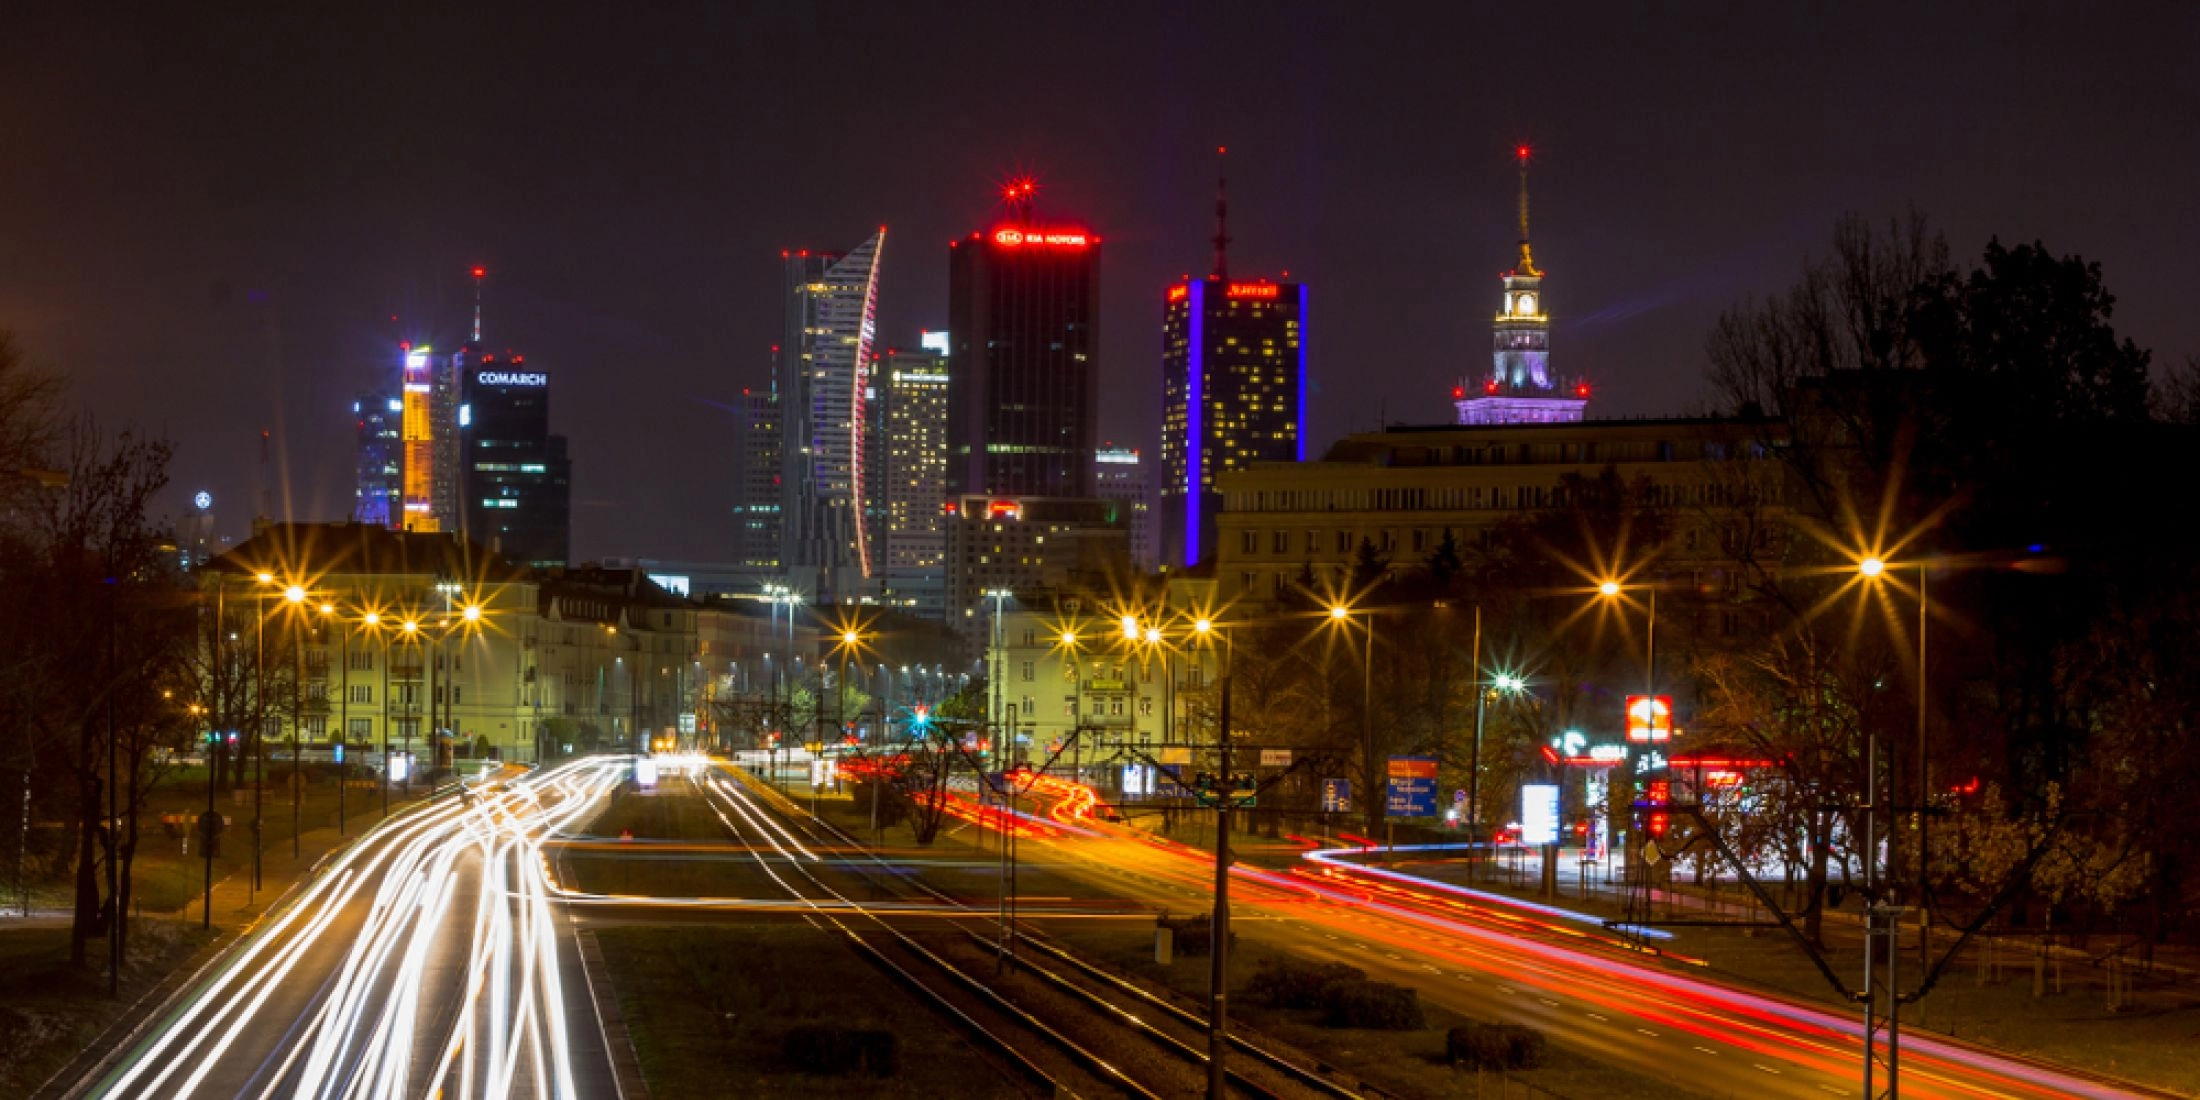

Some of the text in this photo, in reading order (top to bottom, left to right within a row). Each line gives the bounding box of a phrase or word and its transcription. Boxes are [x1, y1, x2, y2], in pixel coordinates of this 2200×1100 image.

[1026, 232, 1086, 245] KIA MOTORS
[479, 371, 547, 386] COMARCH
